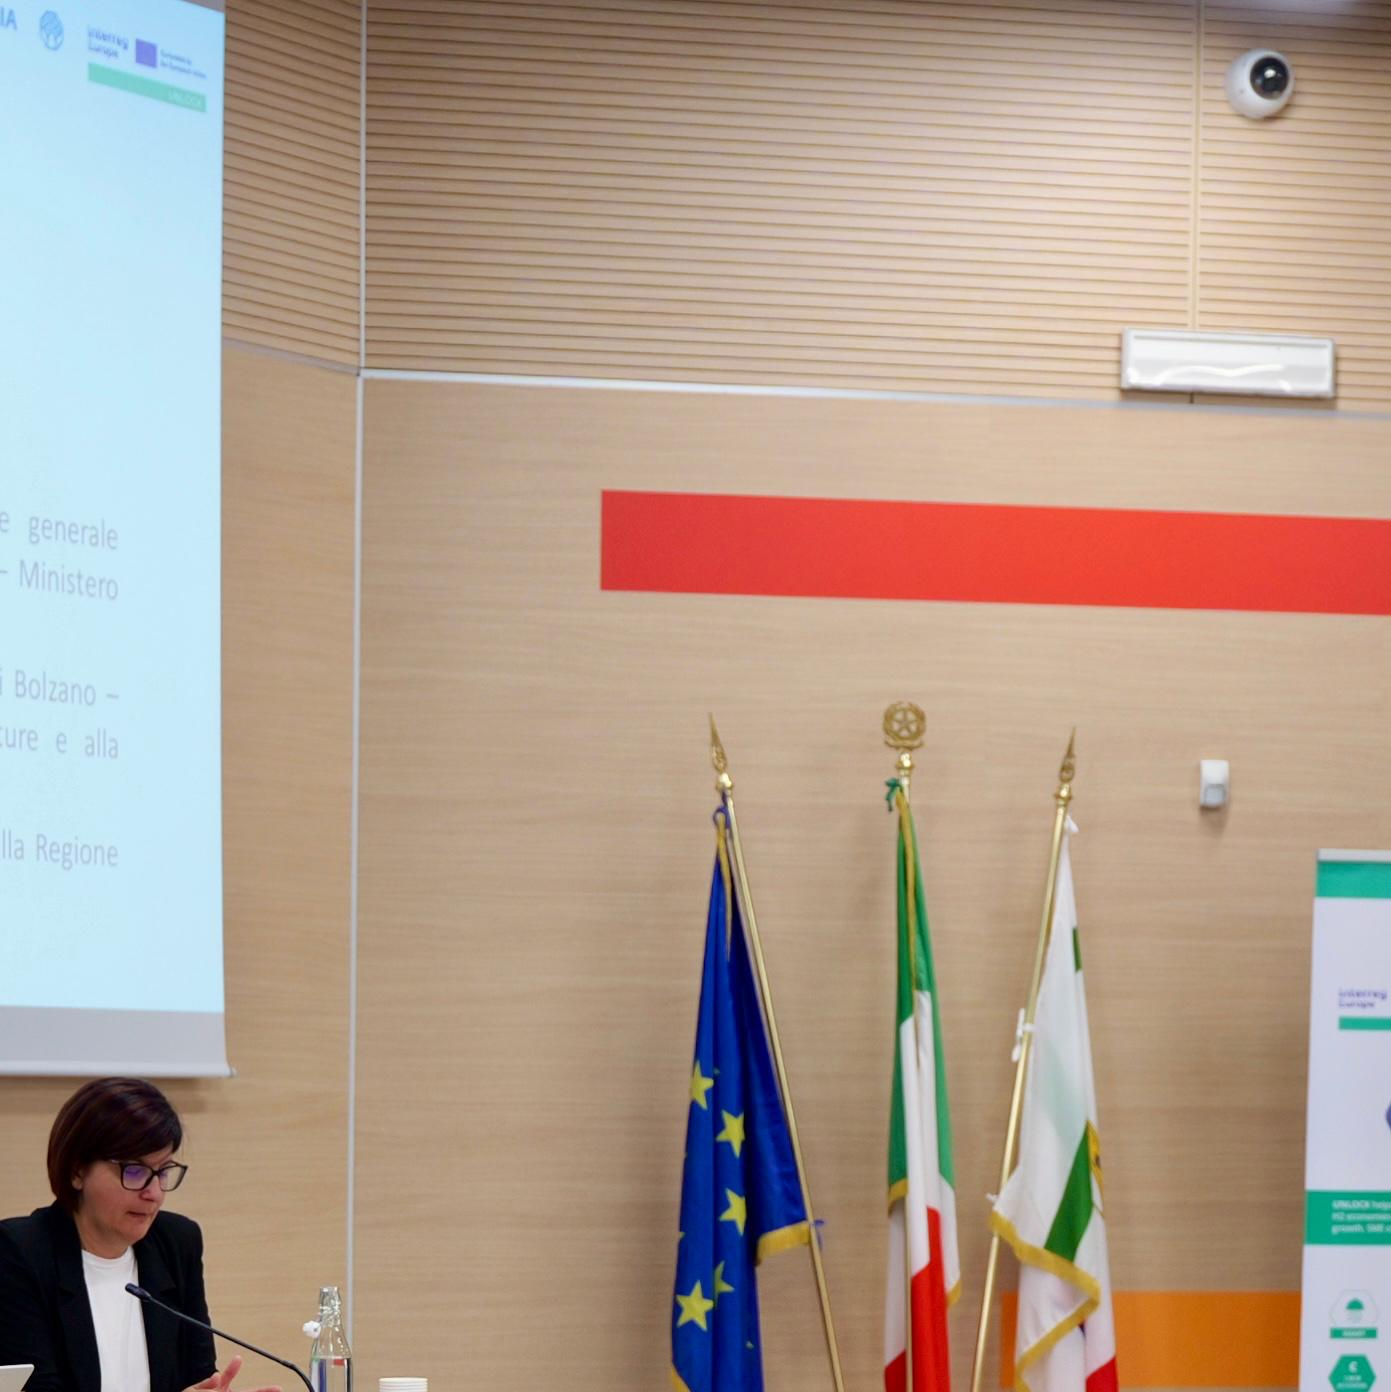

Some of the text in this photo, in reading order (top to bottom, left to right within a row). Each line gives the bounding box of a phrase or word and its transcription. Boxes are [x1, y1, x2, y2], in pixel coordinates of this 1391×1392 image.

[28, 514, 119, 550] generale
[19, 558, 119, 601] Ministero
[15, 669, 97, 706] Bolzano
[55, 730, 67, 754] e
[84, 729, 119, 758] alla
[35, 833, 119, 871] Regione
